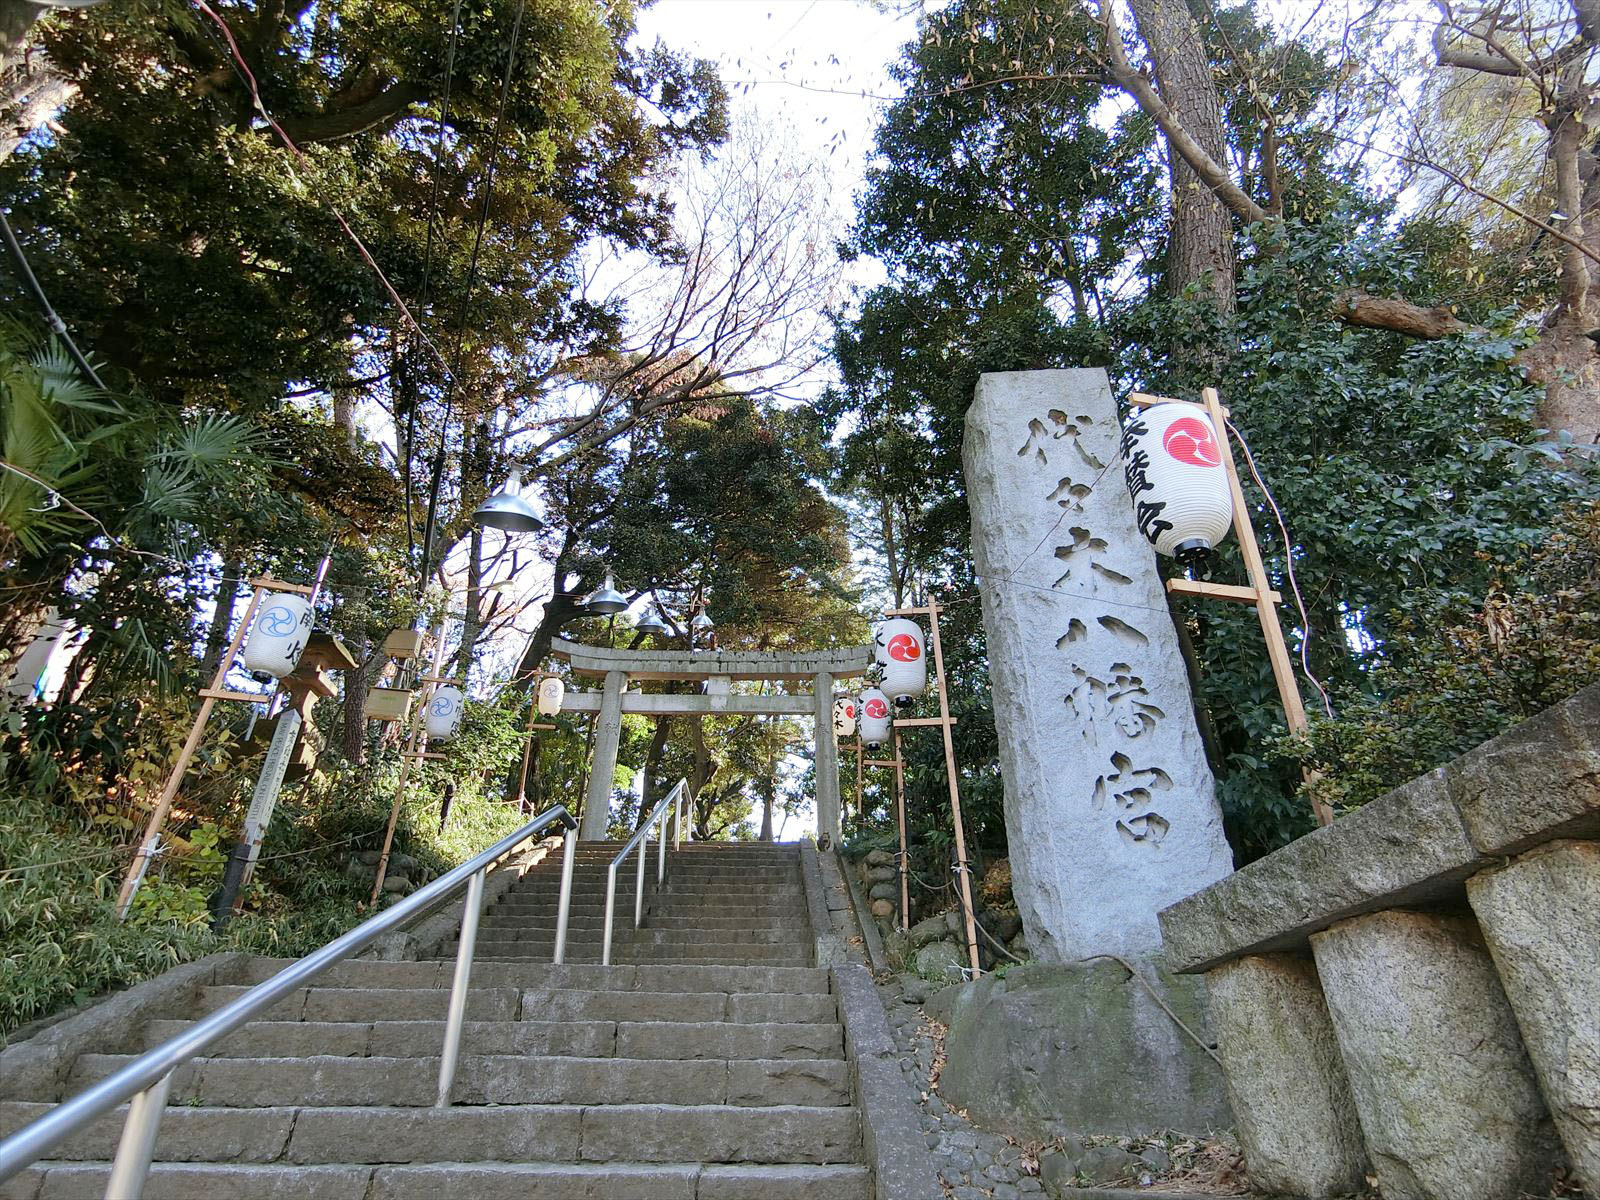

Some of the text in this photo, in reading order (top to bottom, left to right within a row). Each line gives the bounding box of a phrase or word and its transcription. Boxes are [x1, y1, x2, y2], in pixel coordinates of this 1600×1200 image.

[1018, 409, 1172, 850] 代々木八幡宮
[833, 700, 845, 730] 代々木
[269, 736, 285, 758] PEACE
